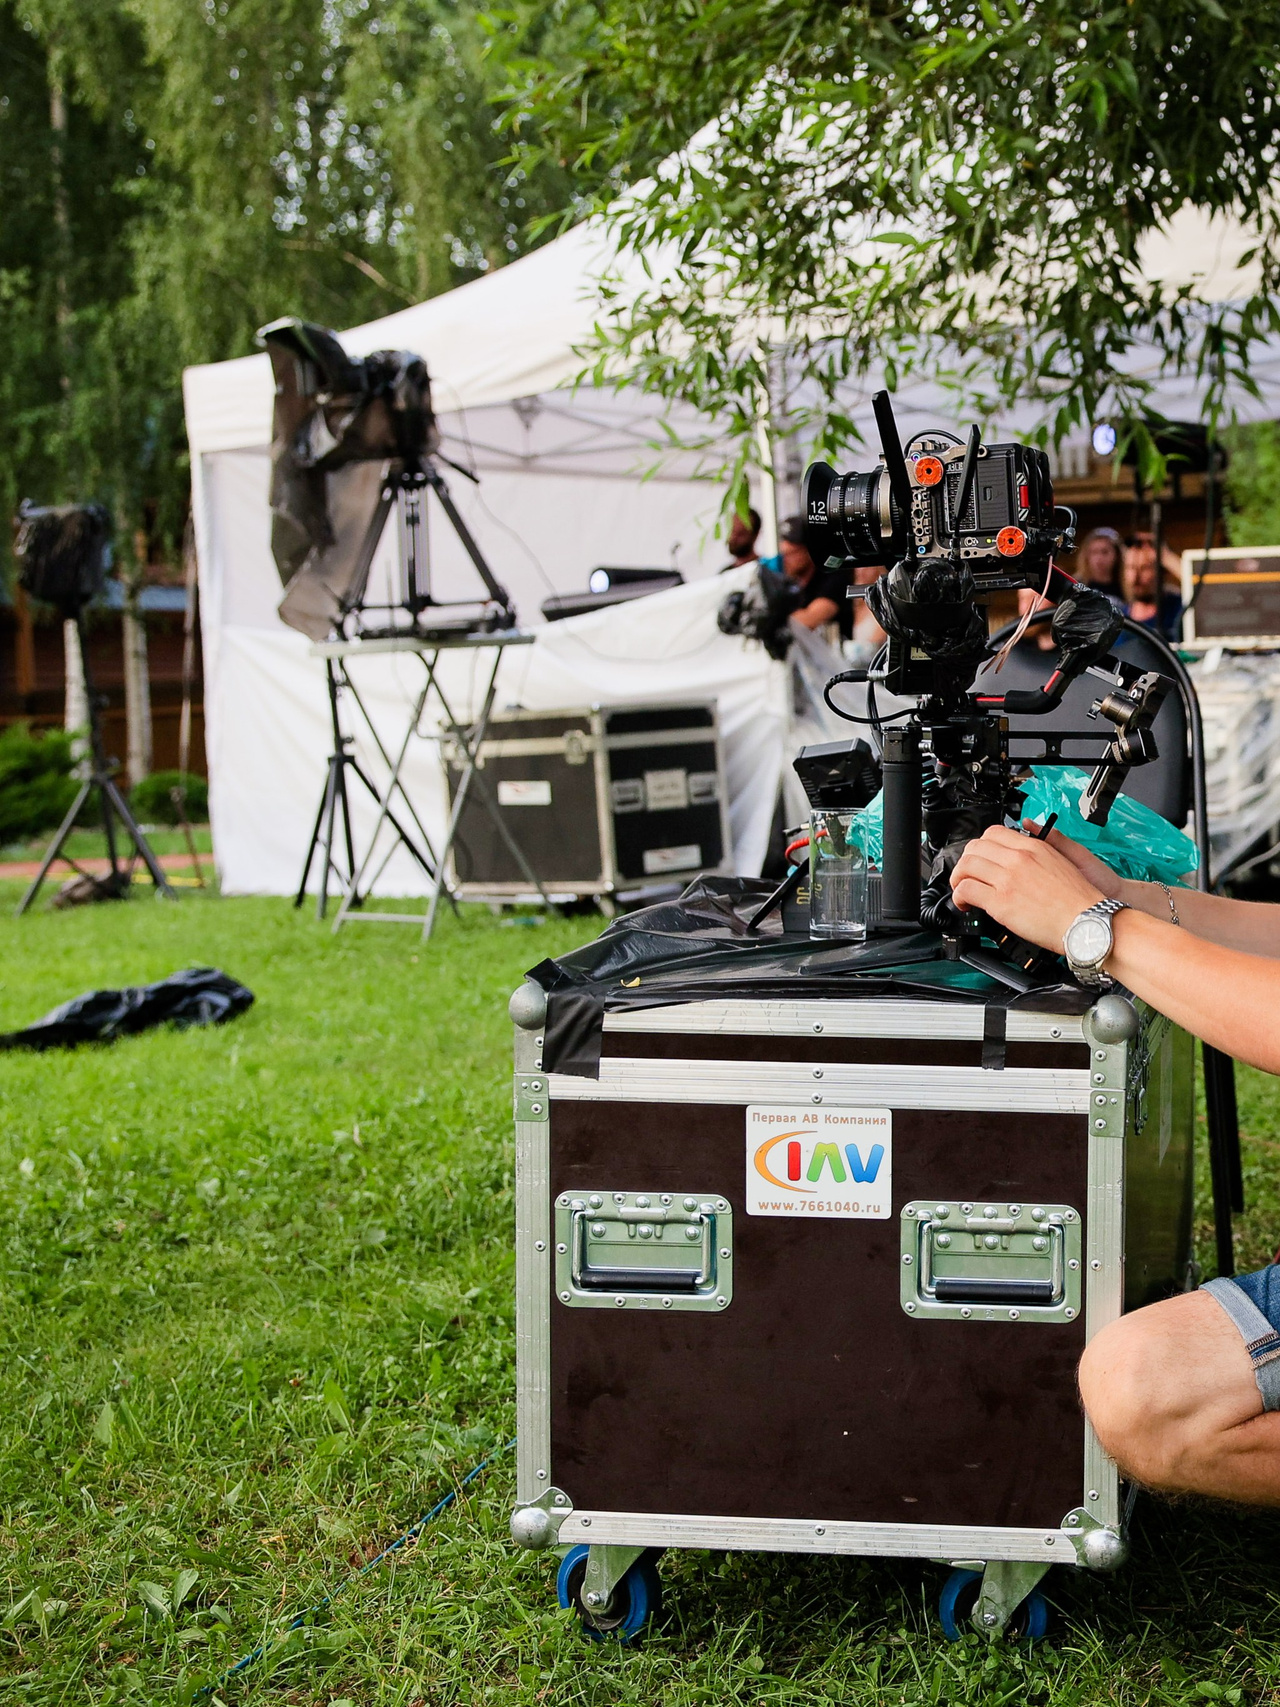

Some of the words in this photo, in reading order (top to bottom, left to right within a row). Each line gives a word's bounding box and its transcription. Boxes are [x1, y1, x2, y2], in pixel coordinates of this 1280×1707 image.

[810, 500, 826, 514] 12
[752, 1112, 797, 1125] Первая
[802, 1113, 819, 1124] АВ
[824, 1114, 887, 1126] Компания
[758, 1200, 881, 1213] www.7661040.ru
